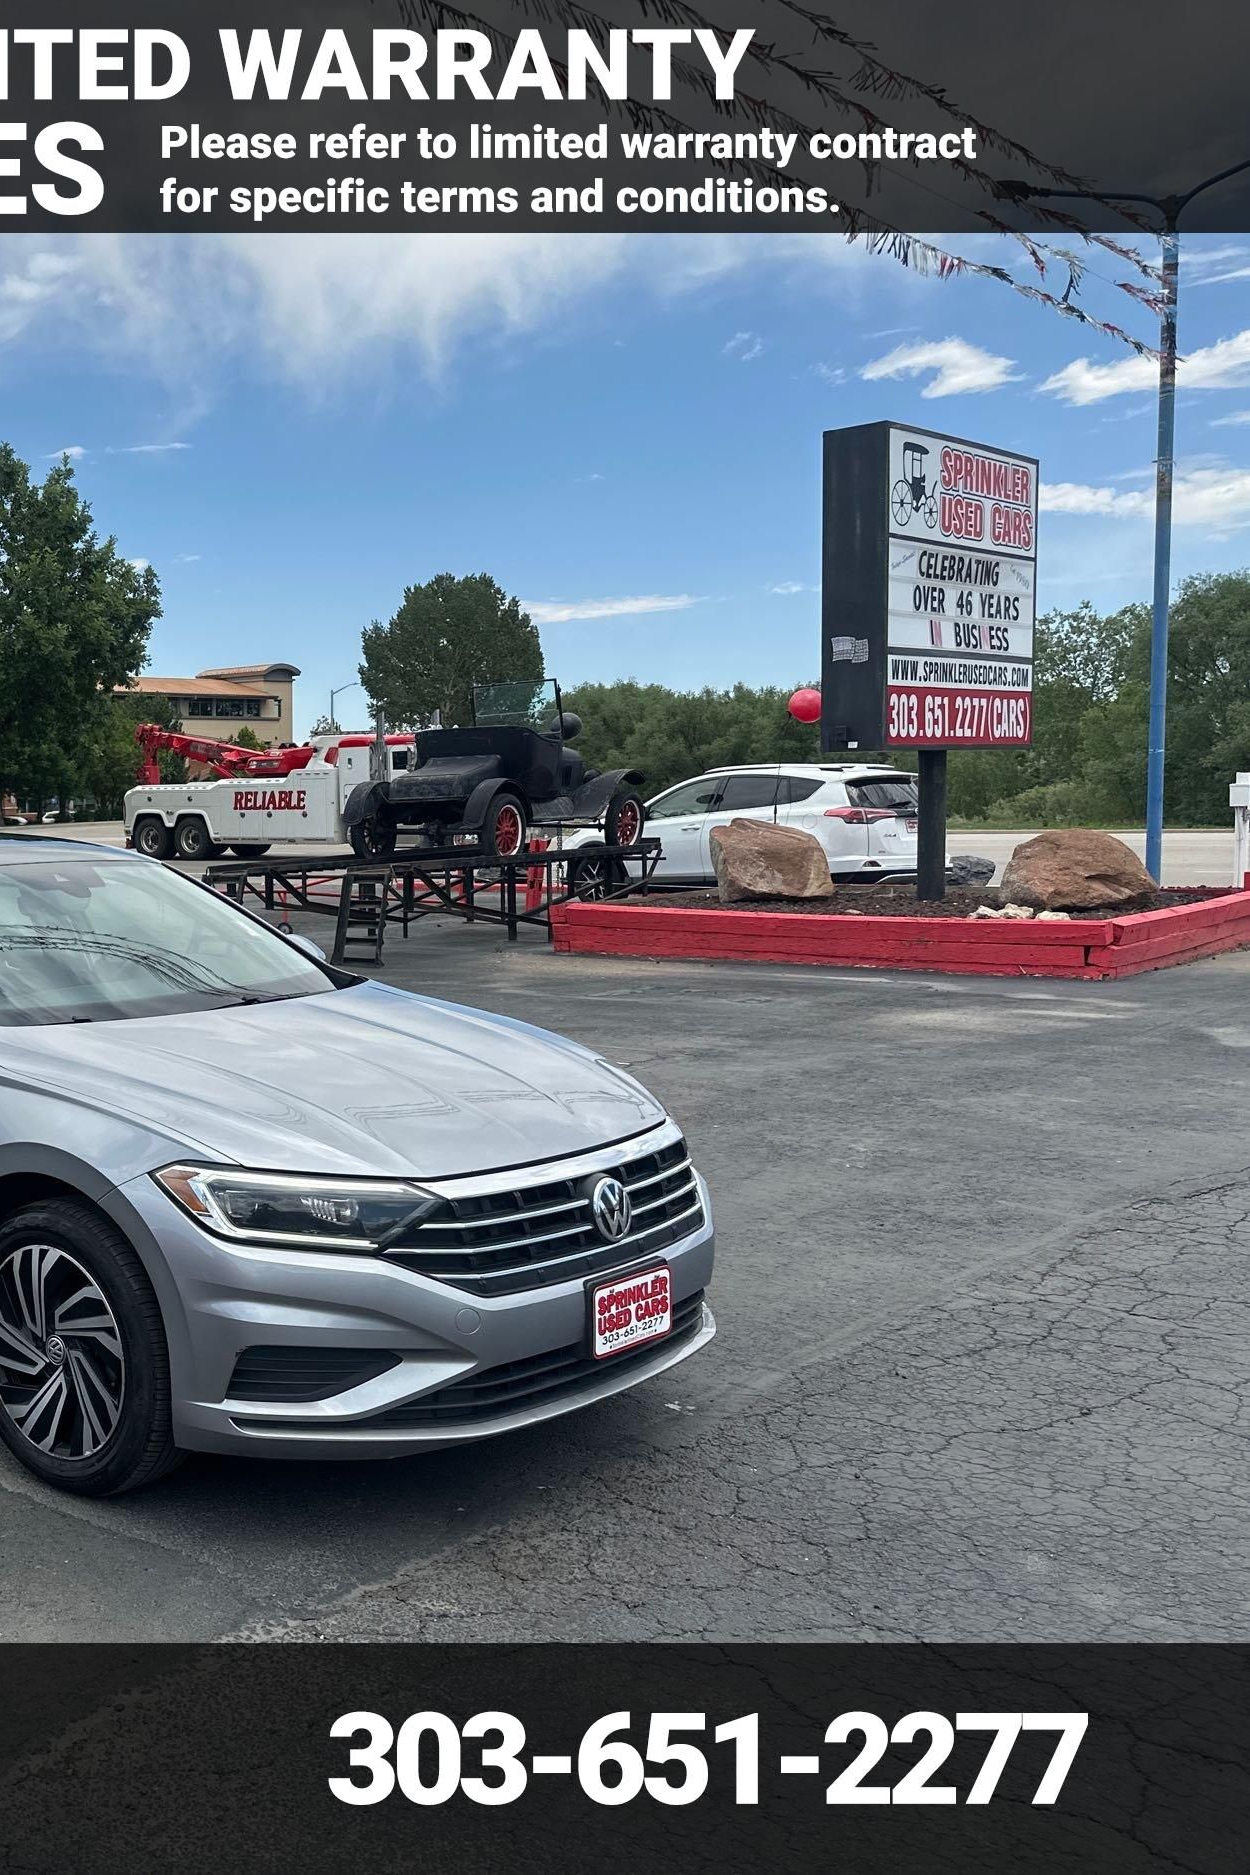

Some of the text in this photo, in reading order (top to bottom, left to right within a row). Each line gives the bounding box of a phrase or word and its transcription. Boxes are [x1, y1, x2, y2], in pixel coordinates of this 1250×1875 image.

[940, 446, 1031, 506] SPRINKLER
[940, 493, 1032, 551] USED CARS
[918, 550, 1000, 587] CELEBRATING
[913, 584, 1020, 620] OVER 46 YEARS
[929, 619, 1010, 651] IN BUSINESS
[891, 657, 1029, 688] WWW.SPRINKLERUSEDCARS.COM
[888, 692, 1030, 743] 303.651.2277(CARS)
[233, 790, 306, 811] RELIABLE
[597, 1276, 668, 1316] SPRINKLER
[598, 1295, 669, 1336] USED CARS
[602, 1315, 664, 1345] 303-651-2277
